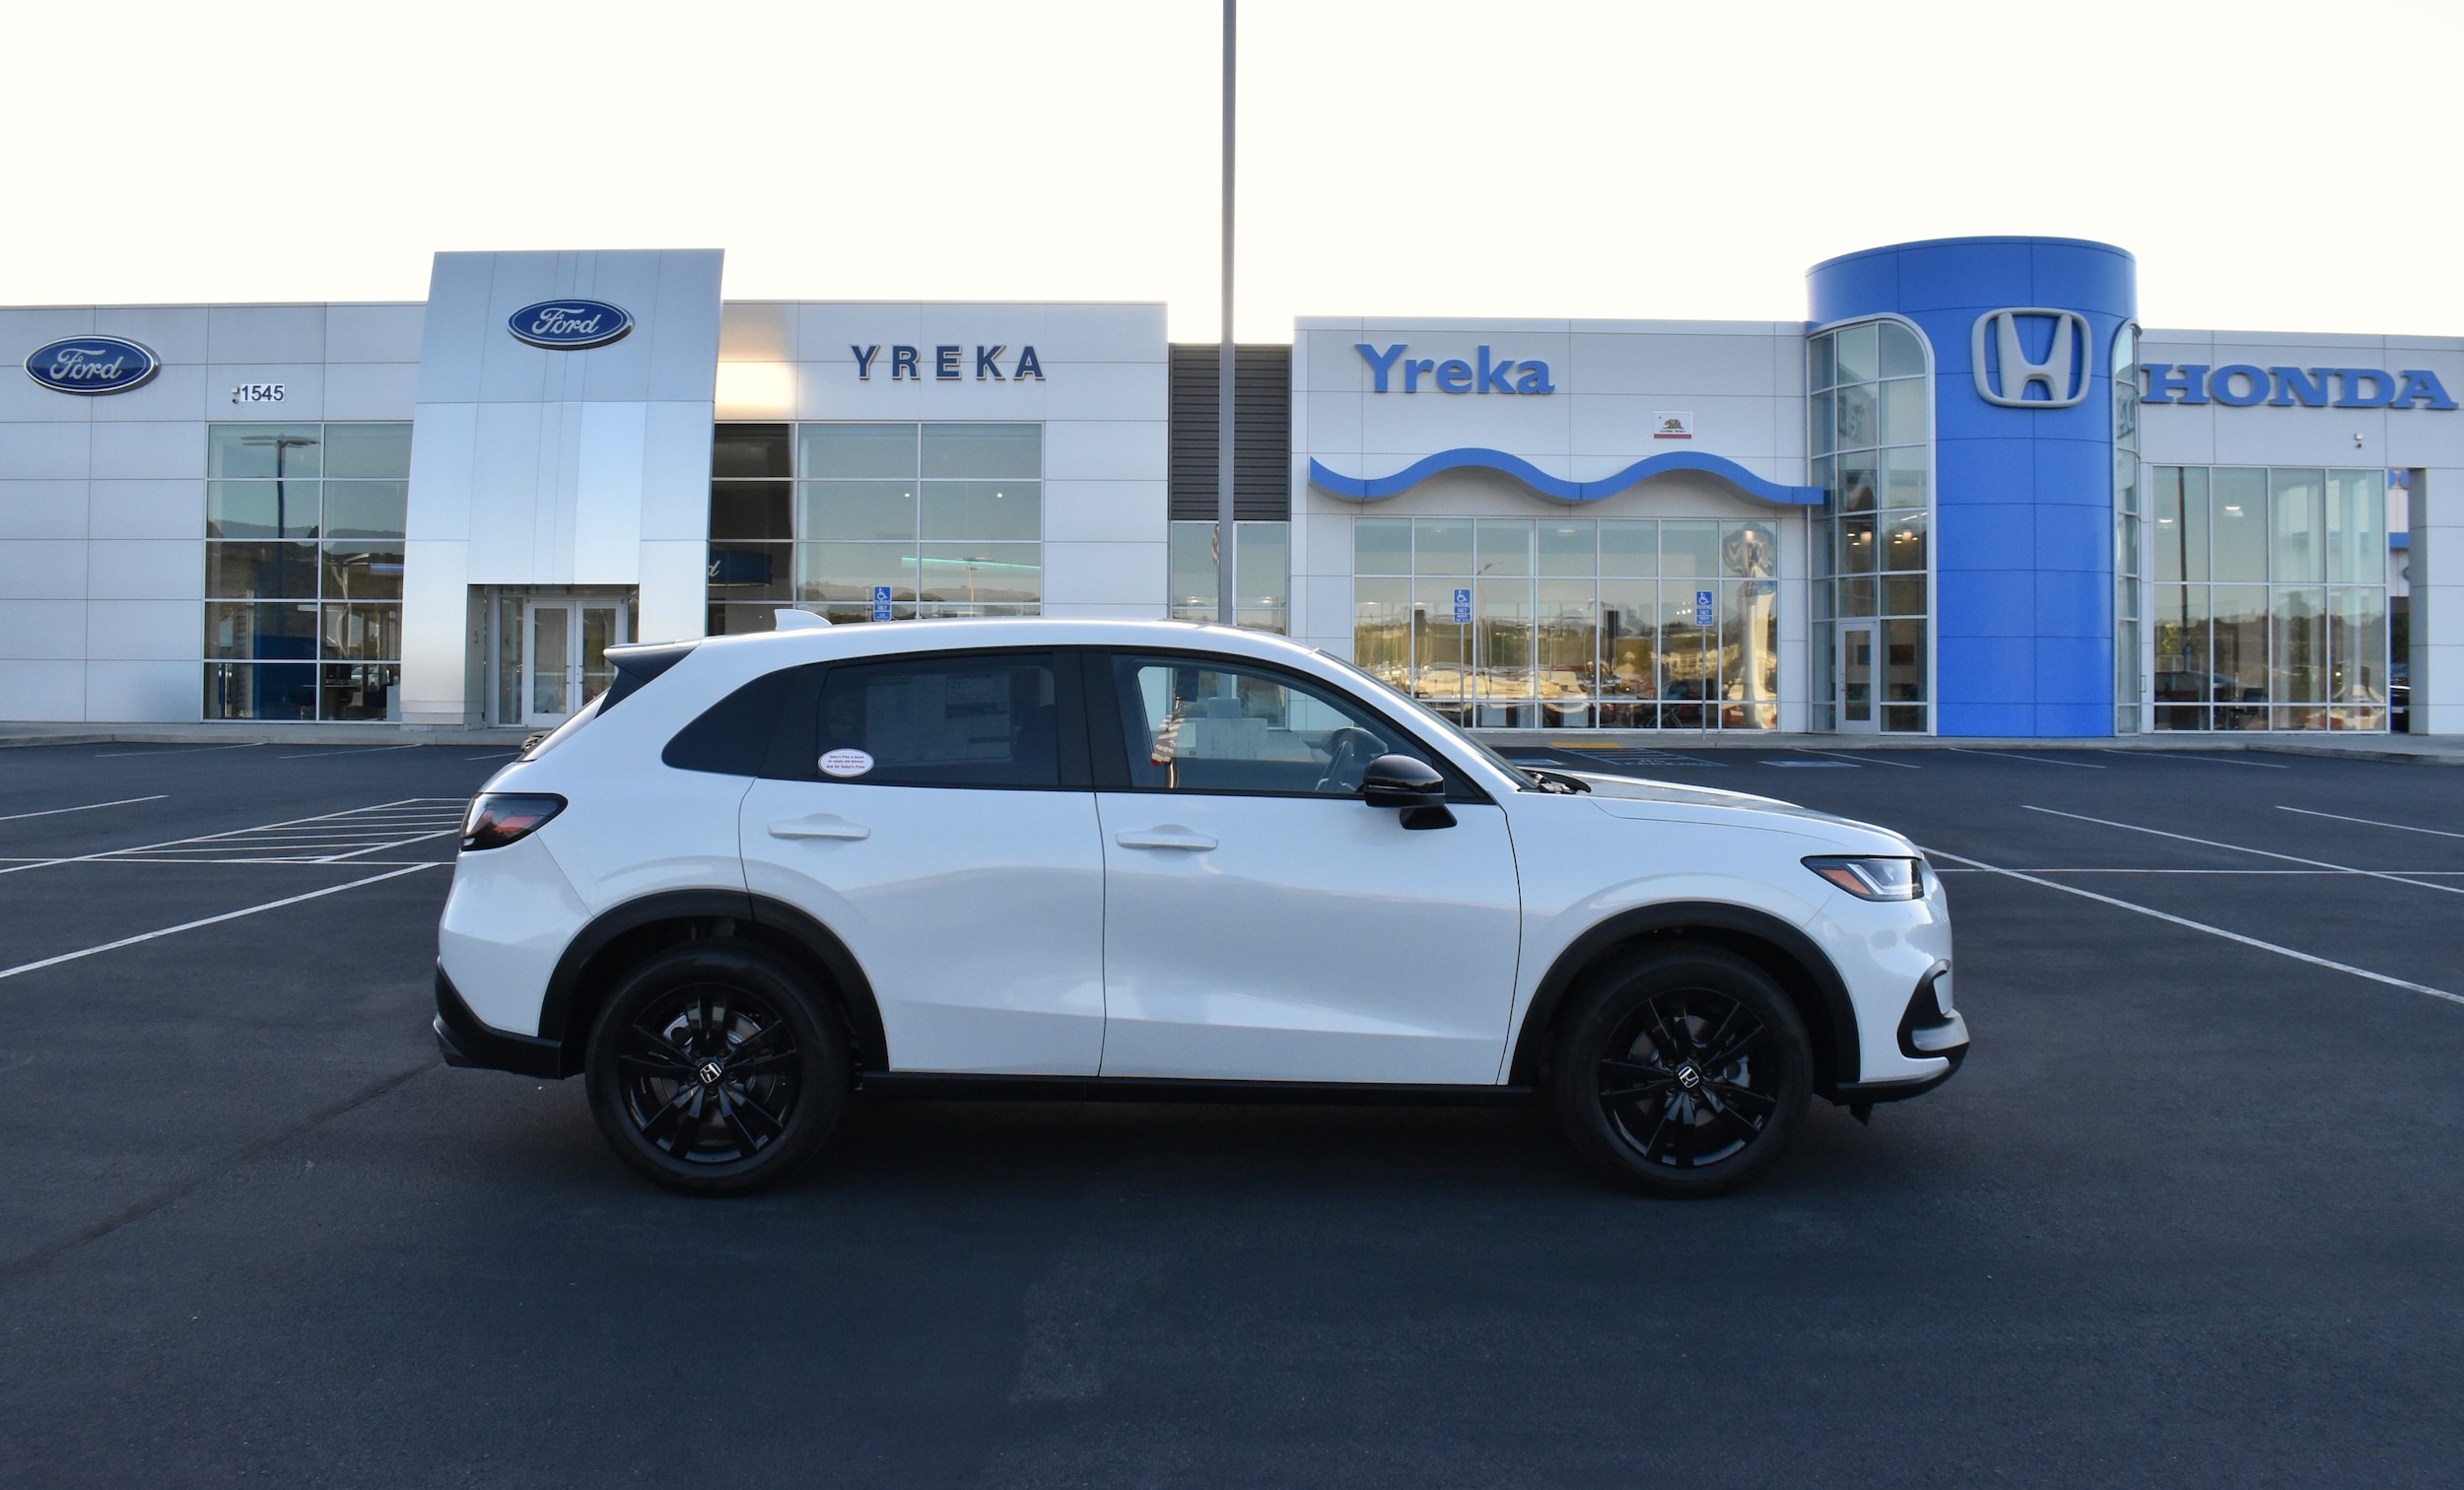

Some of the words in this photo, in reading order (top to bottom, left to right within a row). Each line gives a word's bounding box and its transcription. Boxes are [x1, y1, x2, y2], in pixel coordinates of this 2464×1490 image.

[532, 307, 602, 334] Ford
[49, 348, 124, 380] Ford
[851, 345, 1046, 379] YREKA
[1354, 343, 1555, 394] Yreka
[241, 385, 284, 401] 1545
[2139, 363, 2459, 410] HONDA
